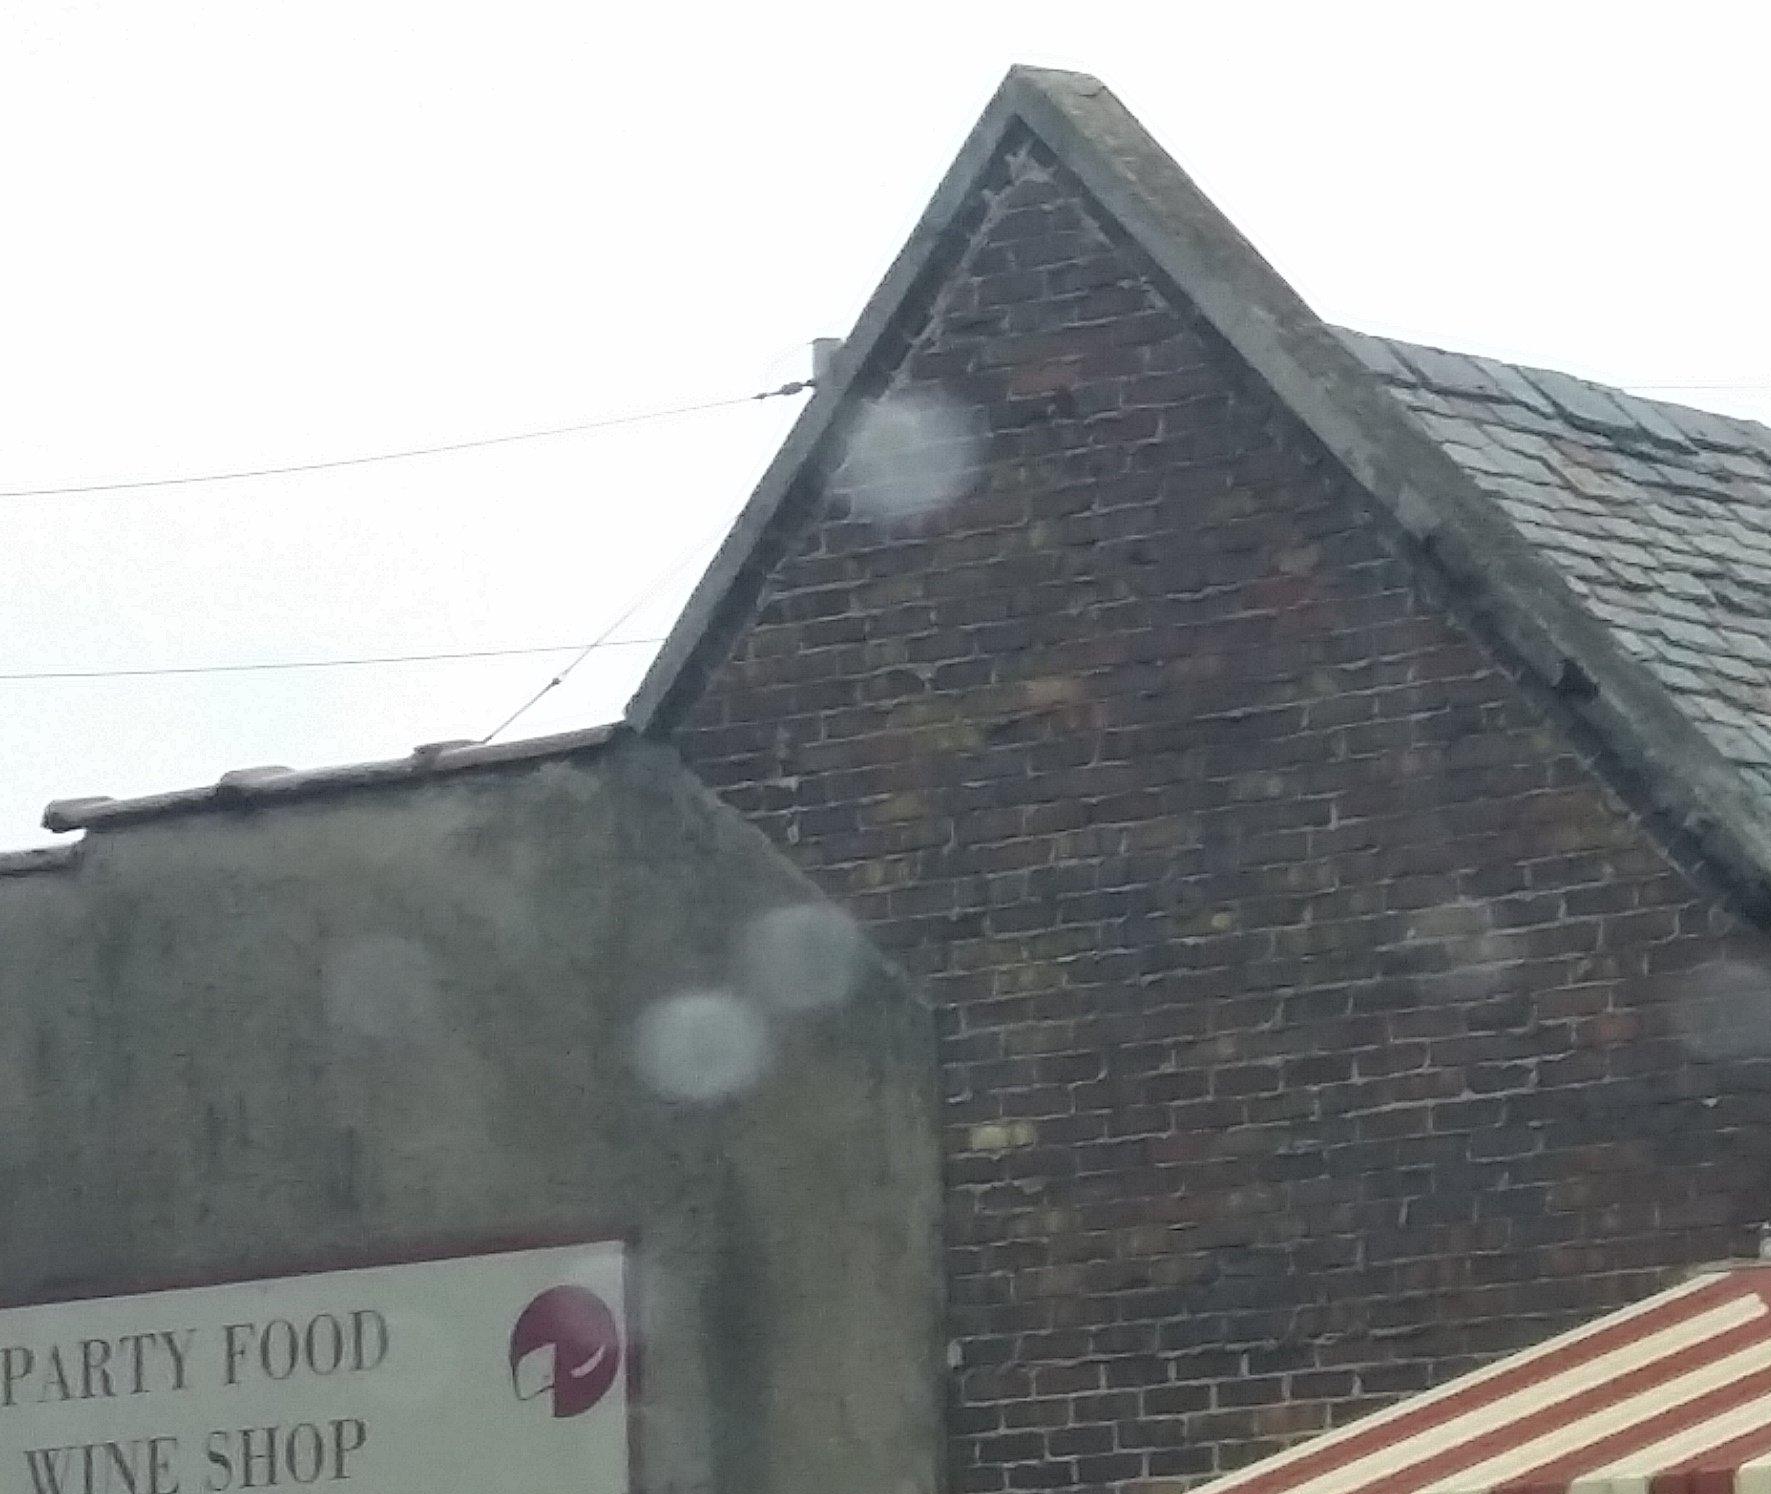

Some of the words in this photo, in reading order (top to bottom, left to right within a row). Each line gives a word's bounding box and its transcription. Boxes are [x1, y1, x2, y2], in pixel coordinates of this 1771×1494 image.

[0, 1326, 197, 1405] PARTY
[223, 1310, 390, 1386] FOOD
[201, 1418, 368, 1492] SHOP
